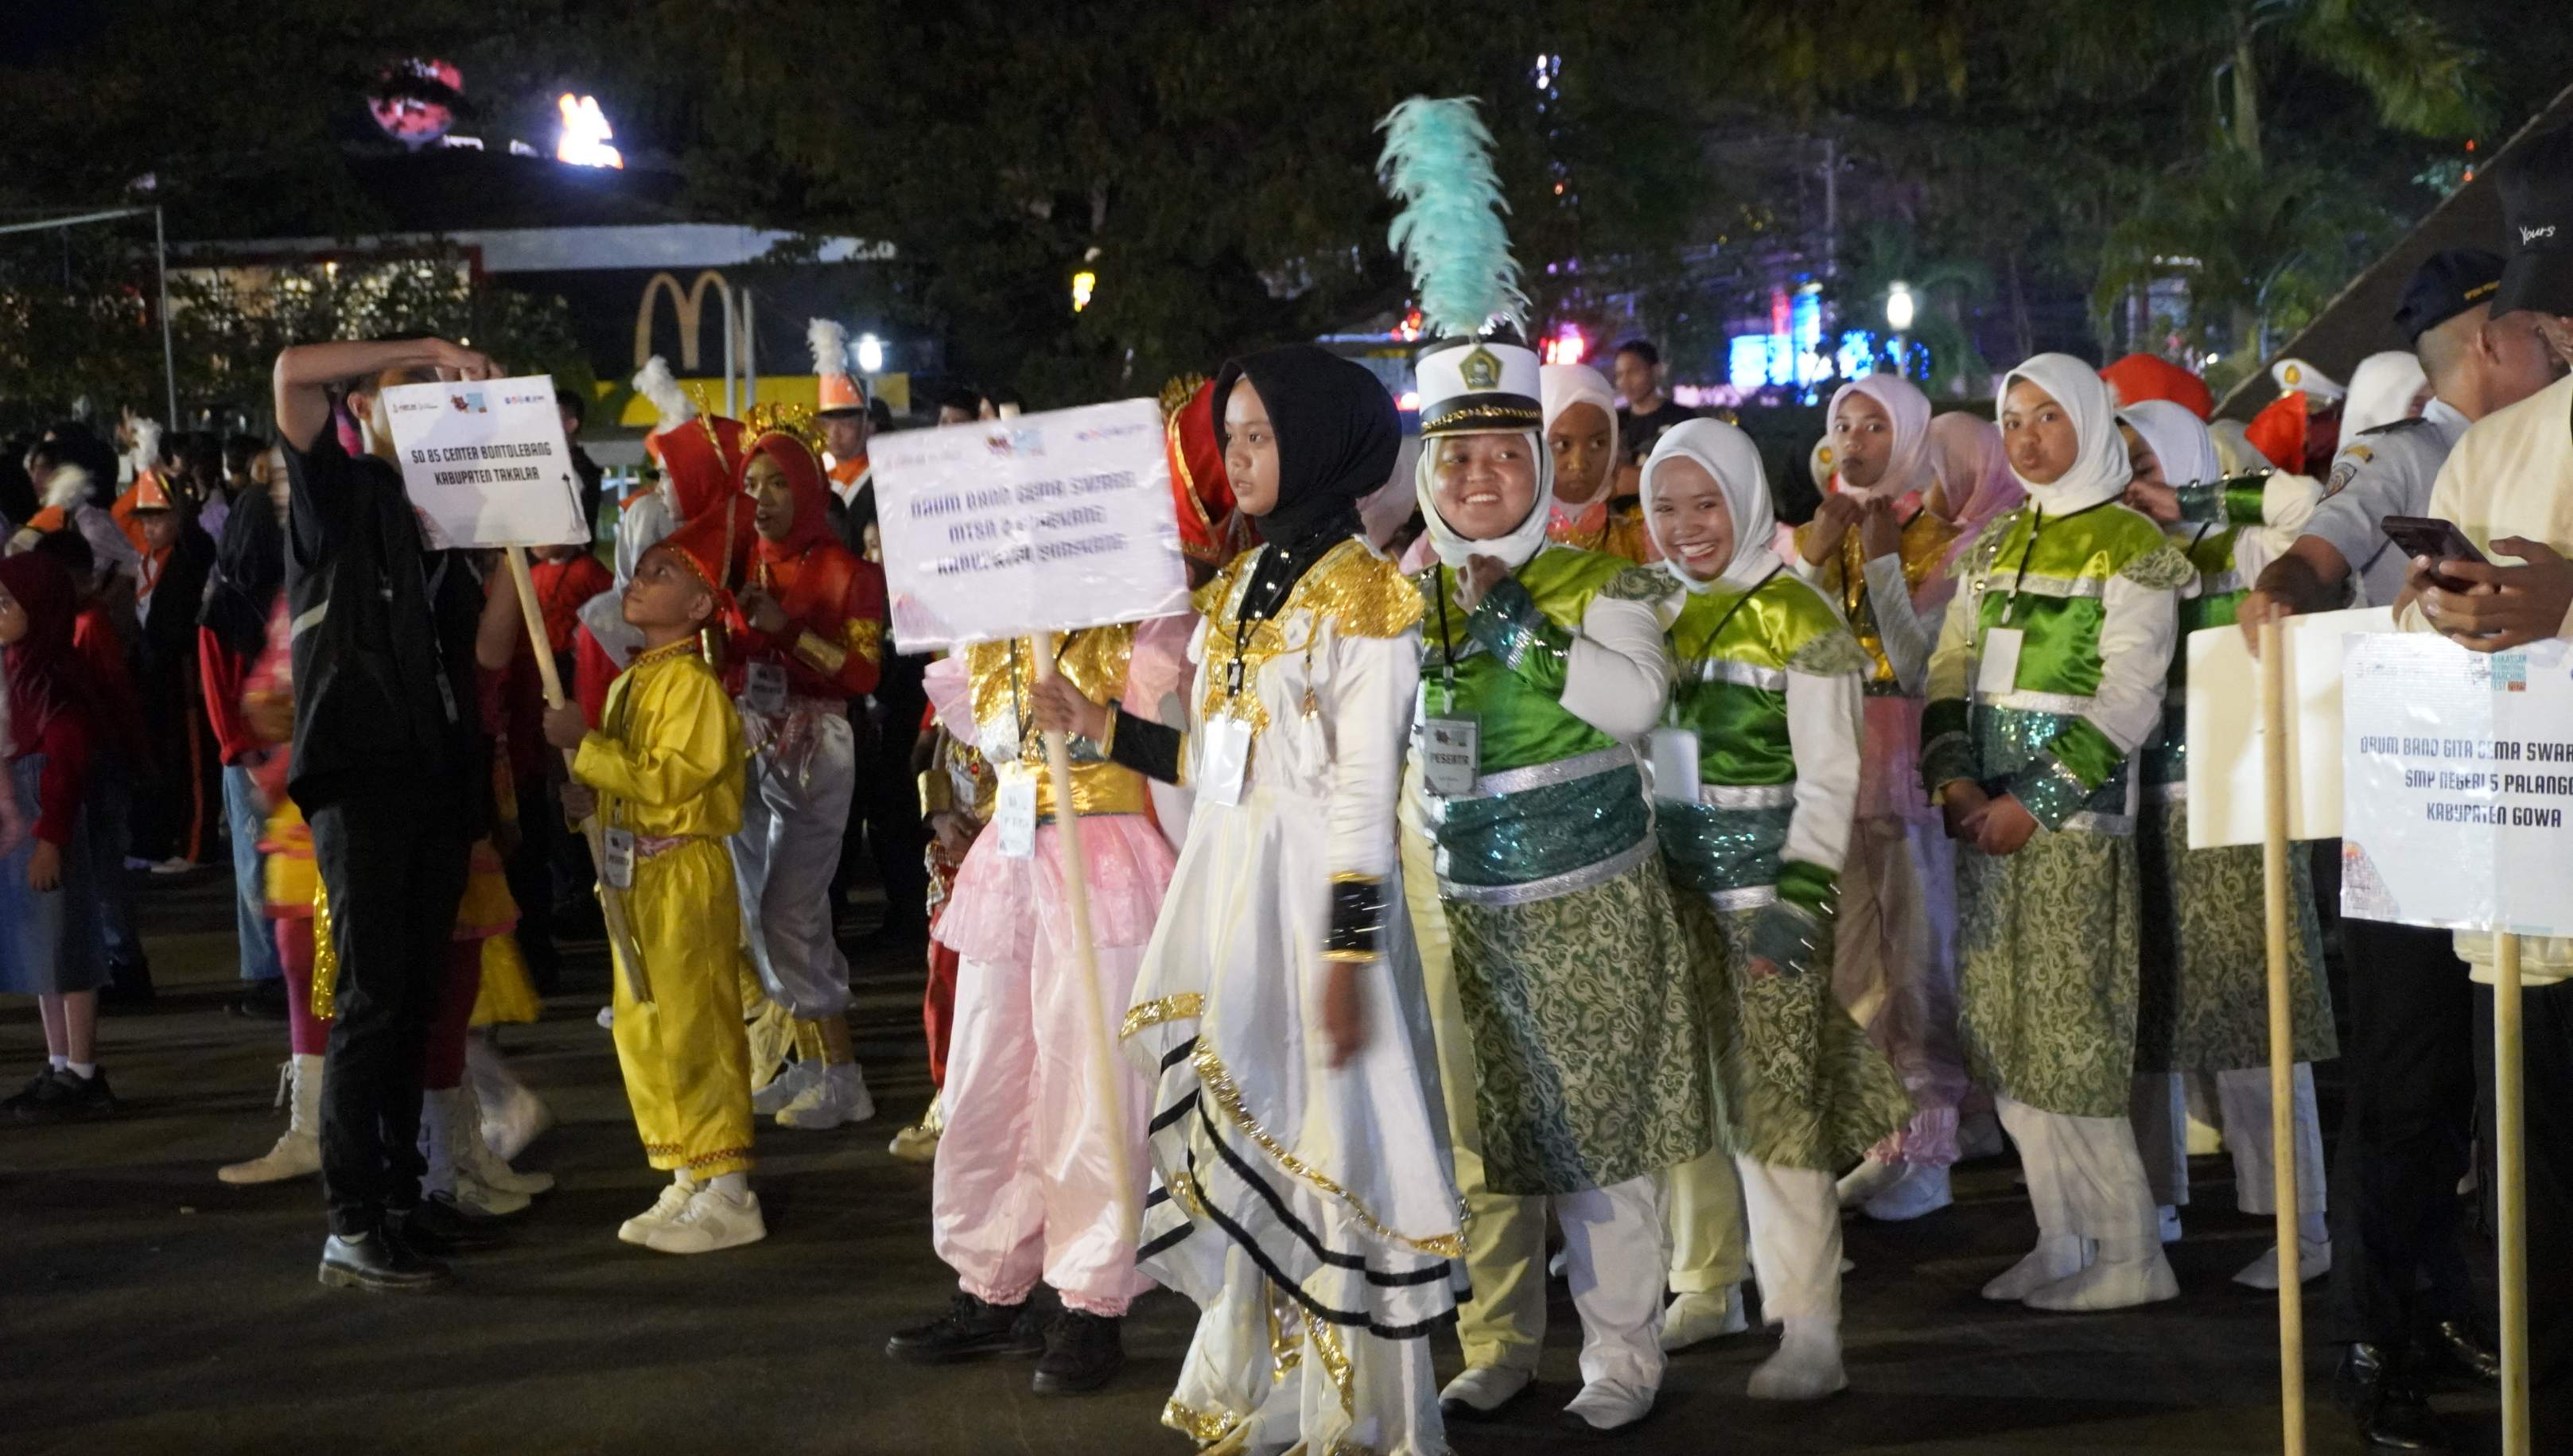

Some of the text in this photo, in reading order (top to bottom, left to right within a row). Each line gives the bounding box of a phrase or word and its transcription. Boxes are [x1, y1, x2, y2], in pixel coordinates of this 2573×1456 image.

[2519, 226, 2556, 246] Yours
[411, 449, 426, 464] SD
[442, 445, 479, 462] CENTER
[480, 441, 552, 460] BONTOLEBANG
[433, 466, 540, 486] KABUPATEN TAKALAR
[2361, 736, 2399, 755] DRUM
[2404, 737, 2439, 757] BAND
[2443, 739, 2474, 759] GITA
[2405, 769, 2435, 788] SMP
[2439, 771, 2486, 791] NEGERI
[2490, 773, 2498, 792] 5
[2427, 802, 2561, 828] KABUPATEN GOWA
